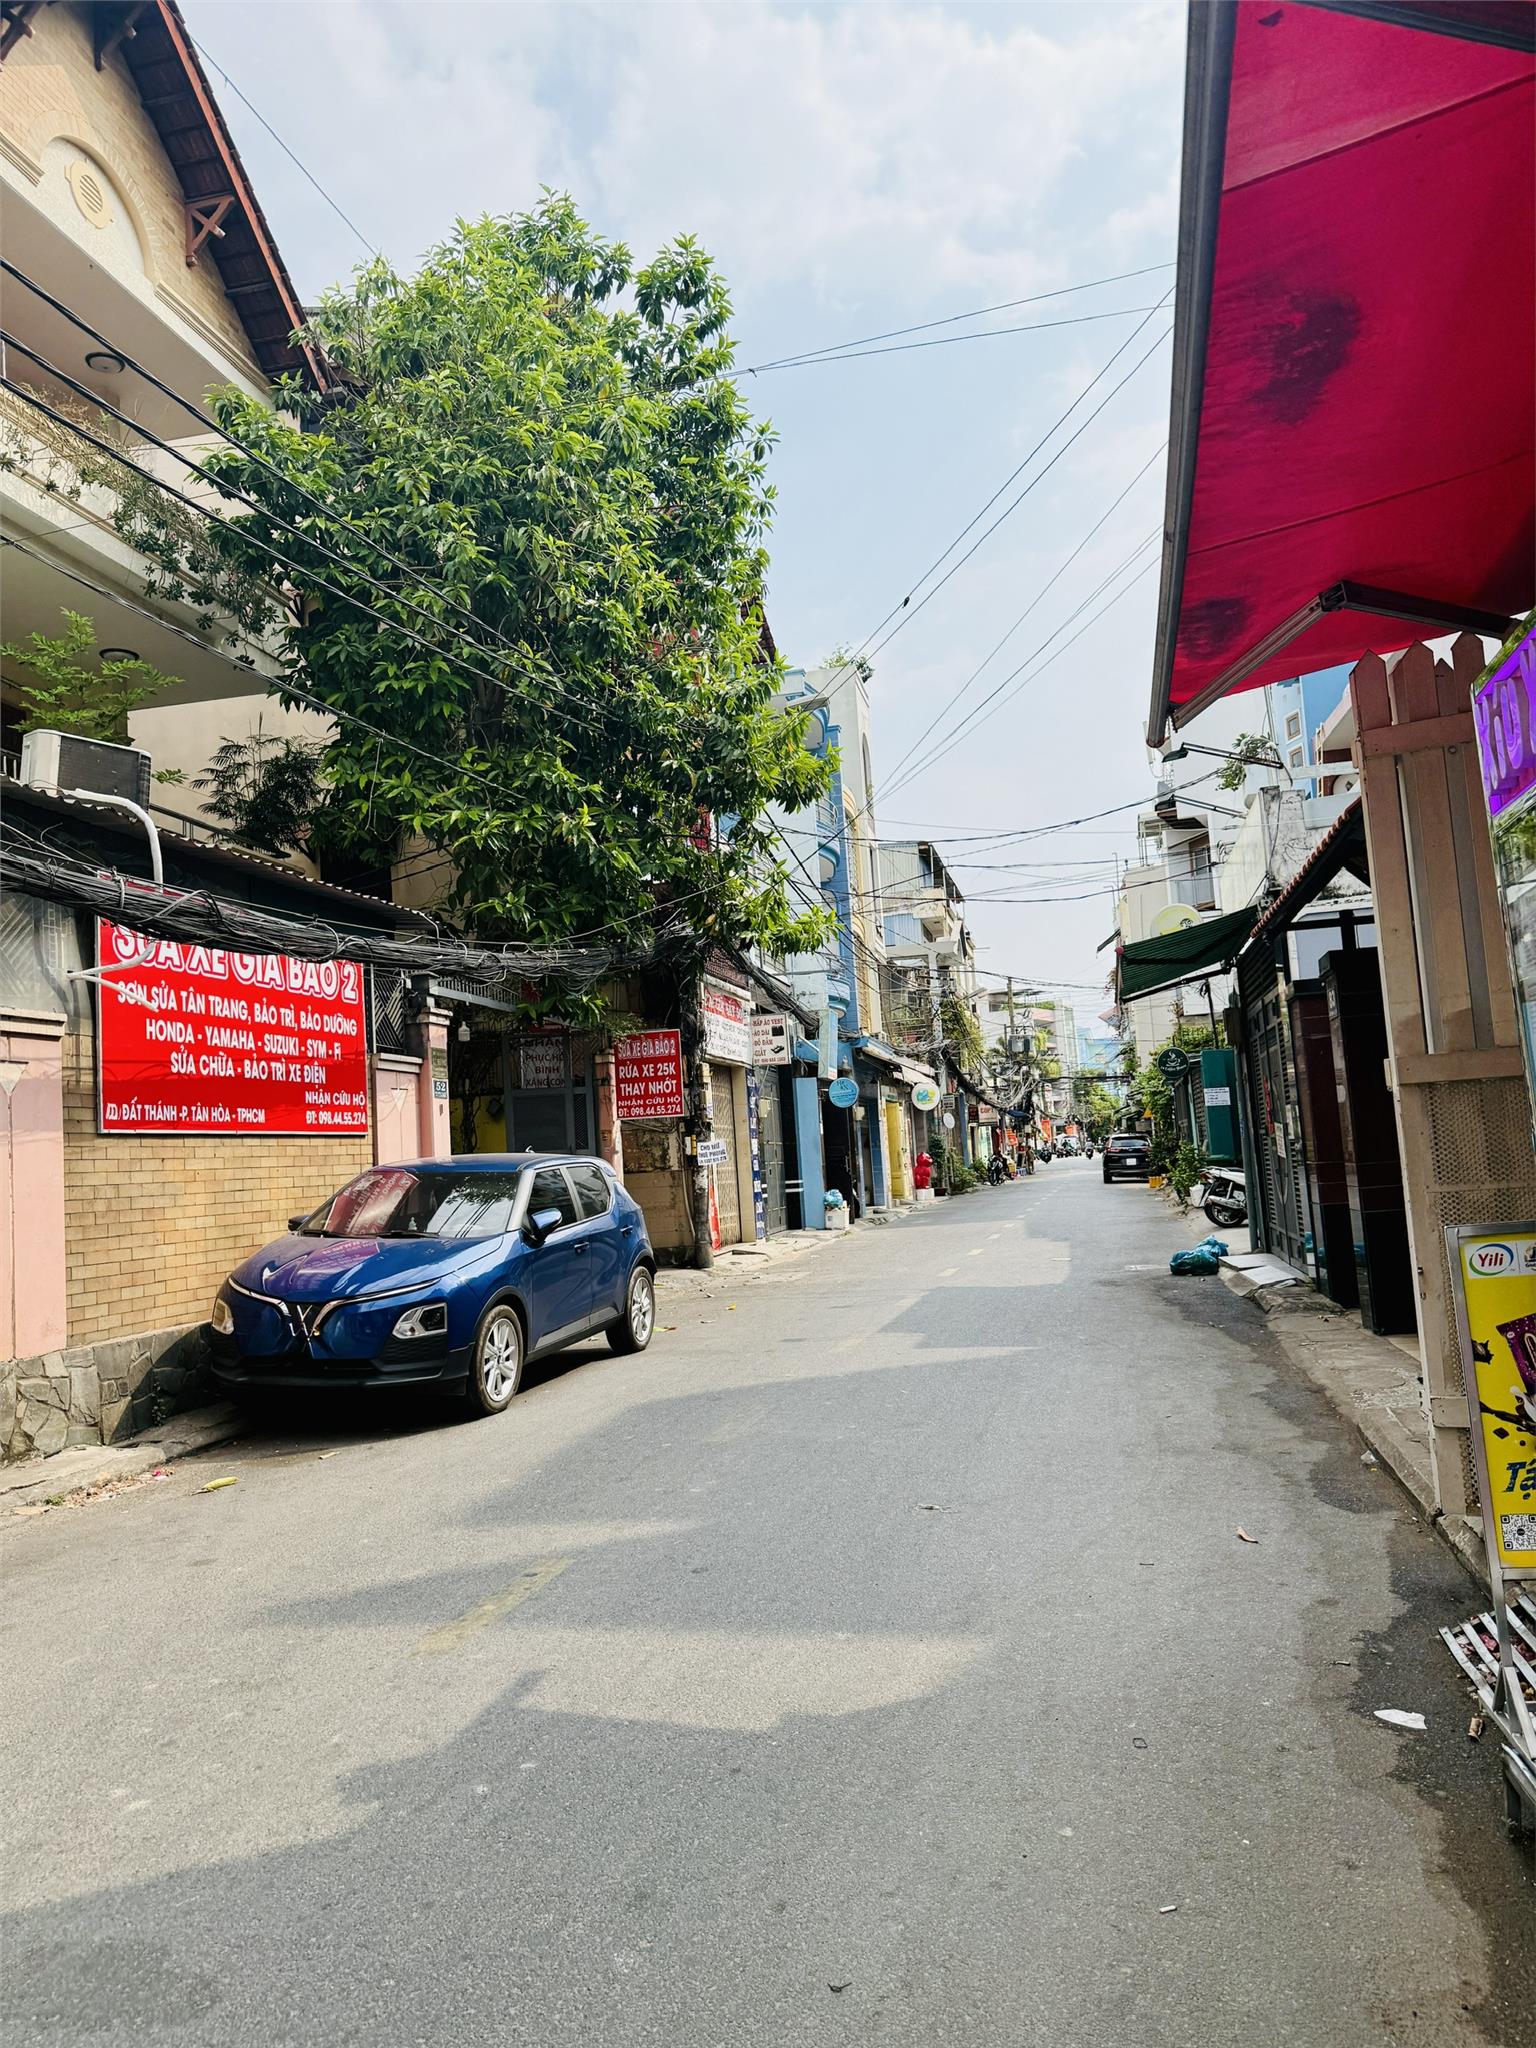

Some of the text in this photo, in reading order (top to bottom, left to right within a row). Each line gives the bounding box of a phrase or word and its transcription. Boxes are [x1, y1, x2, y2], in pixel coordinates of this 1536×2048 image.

[341, 959, 358, 1004] 2
[180, 986, 206, 1014] TÂN
[208, 995, 251, 1024] TRANG,
[254, 997, 277, 1024] BẢO
[300, 1005, 321, 1031] BẢO
[146, 1018, 195, 1044] HONDA
[204, 1025, 256, 1051] YAMAHA
[263, 1033, 299, 1056] SUZUKI
[306, 1039, 327, 1059] SYM
[654, 1033, 670, 1057] BẢO
[670, 1037, 677, 1056] 2
[170, 1045, 196, 1074] SỬA
[199, 1051, 235, 1077] CHỮA
[244, 1053, 268, 1080] BẢO
[270, 1057, 286, 1081] TRÌ
[288, 1063, 301, 1082] XE
[304, 1060, 326, 1089] ĐIỆN
[619, 1061, 676, 1079] RỬA XE 25K
[435, 1081, 446, 1092] 52
[620, 1077, 677, 1097] THAY NHỚT
[305, 1088, 366, 1109] NHẬN CỨU HỘ
[618, 1094, 681, 1108] NHẬN CỨU HỘ
[122, 1096, 141, 1120] ĐẤT
[144, 1100, 177, 1121] THÁNH
[191, 1102, 209, 1122] TÂN
[211, 1102, 231, 1122] HÒA
[237, 1107, 265, 1123] TPHCM
[630, 1104, 681, 1116] 098.44.55.274
[1478, 1252, 1504, 1267] Yili
